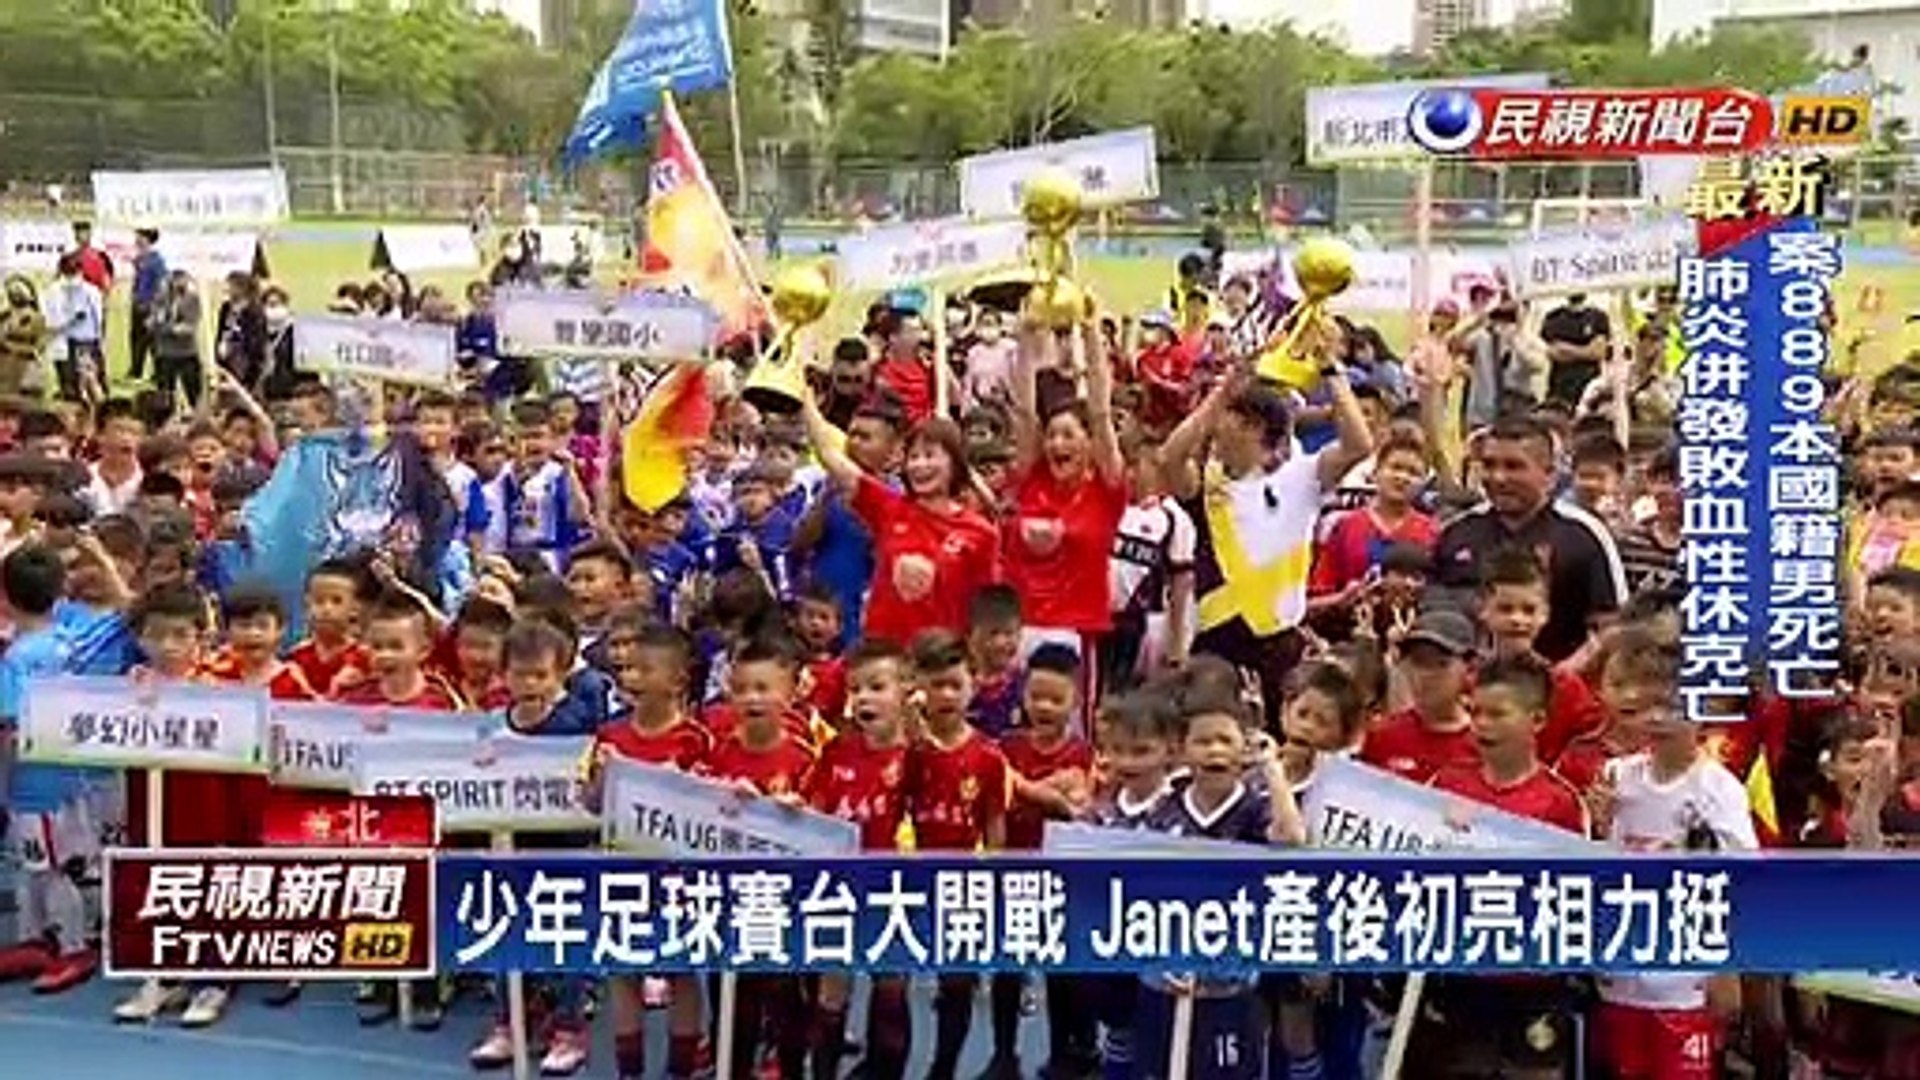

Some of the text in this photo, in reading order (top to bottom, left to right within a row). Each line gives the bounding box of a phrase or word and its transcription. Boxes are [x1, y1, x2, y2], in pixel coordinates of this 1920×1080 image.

[68, 712, 220, 748] 夢幻小星星
[417, 780, 506, 808] SPIRIT
[632, 802, 677, 842] TFA
[1322, 805, 1373, 850] TFA
